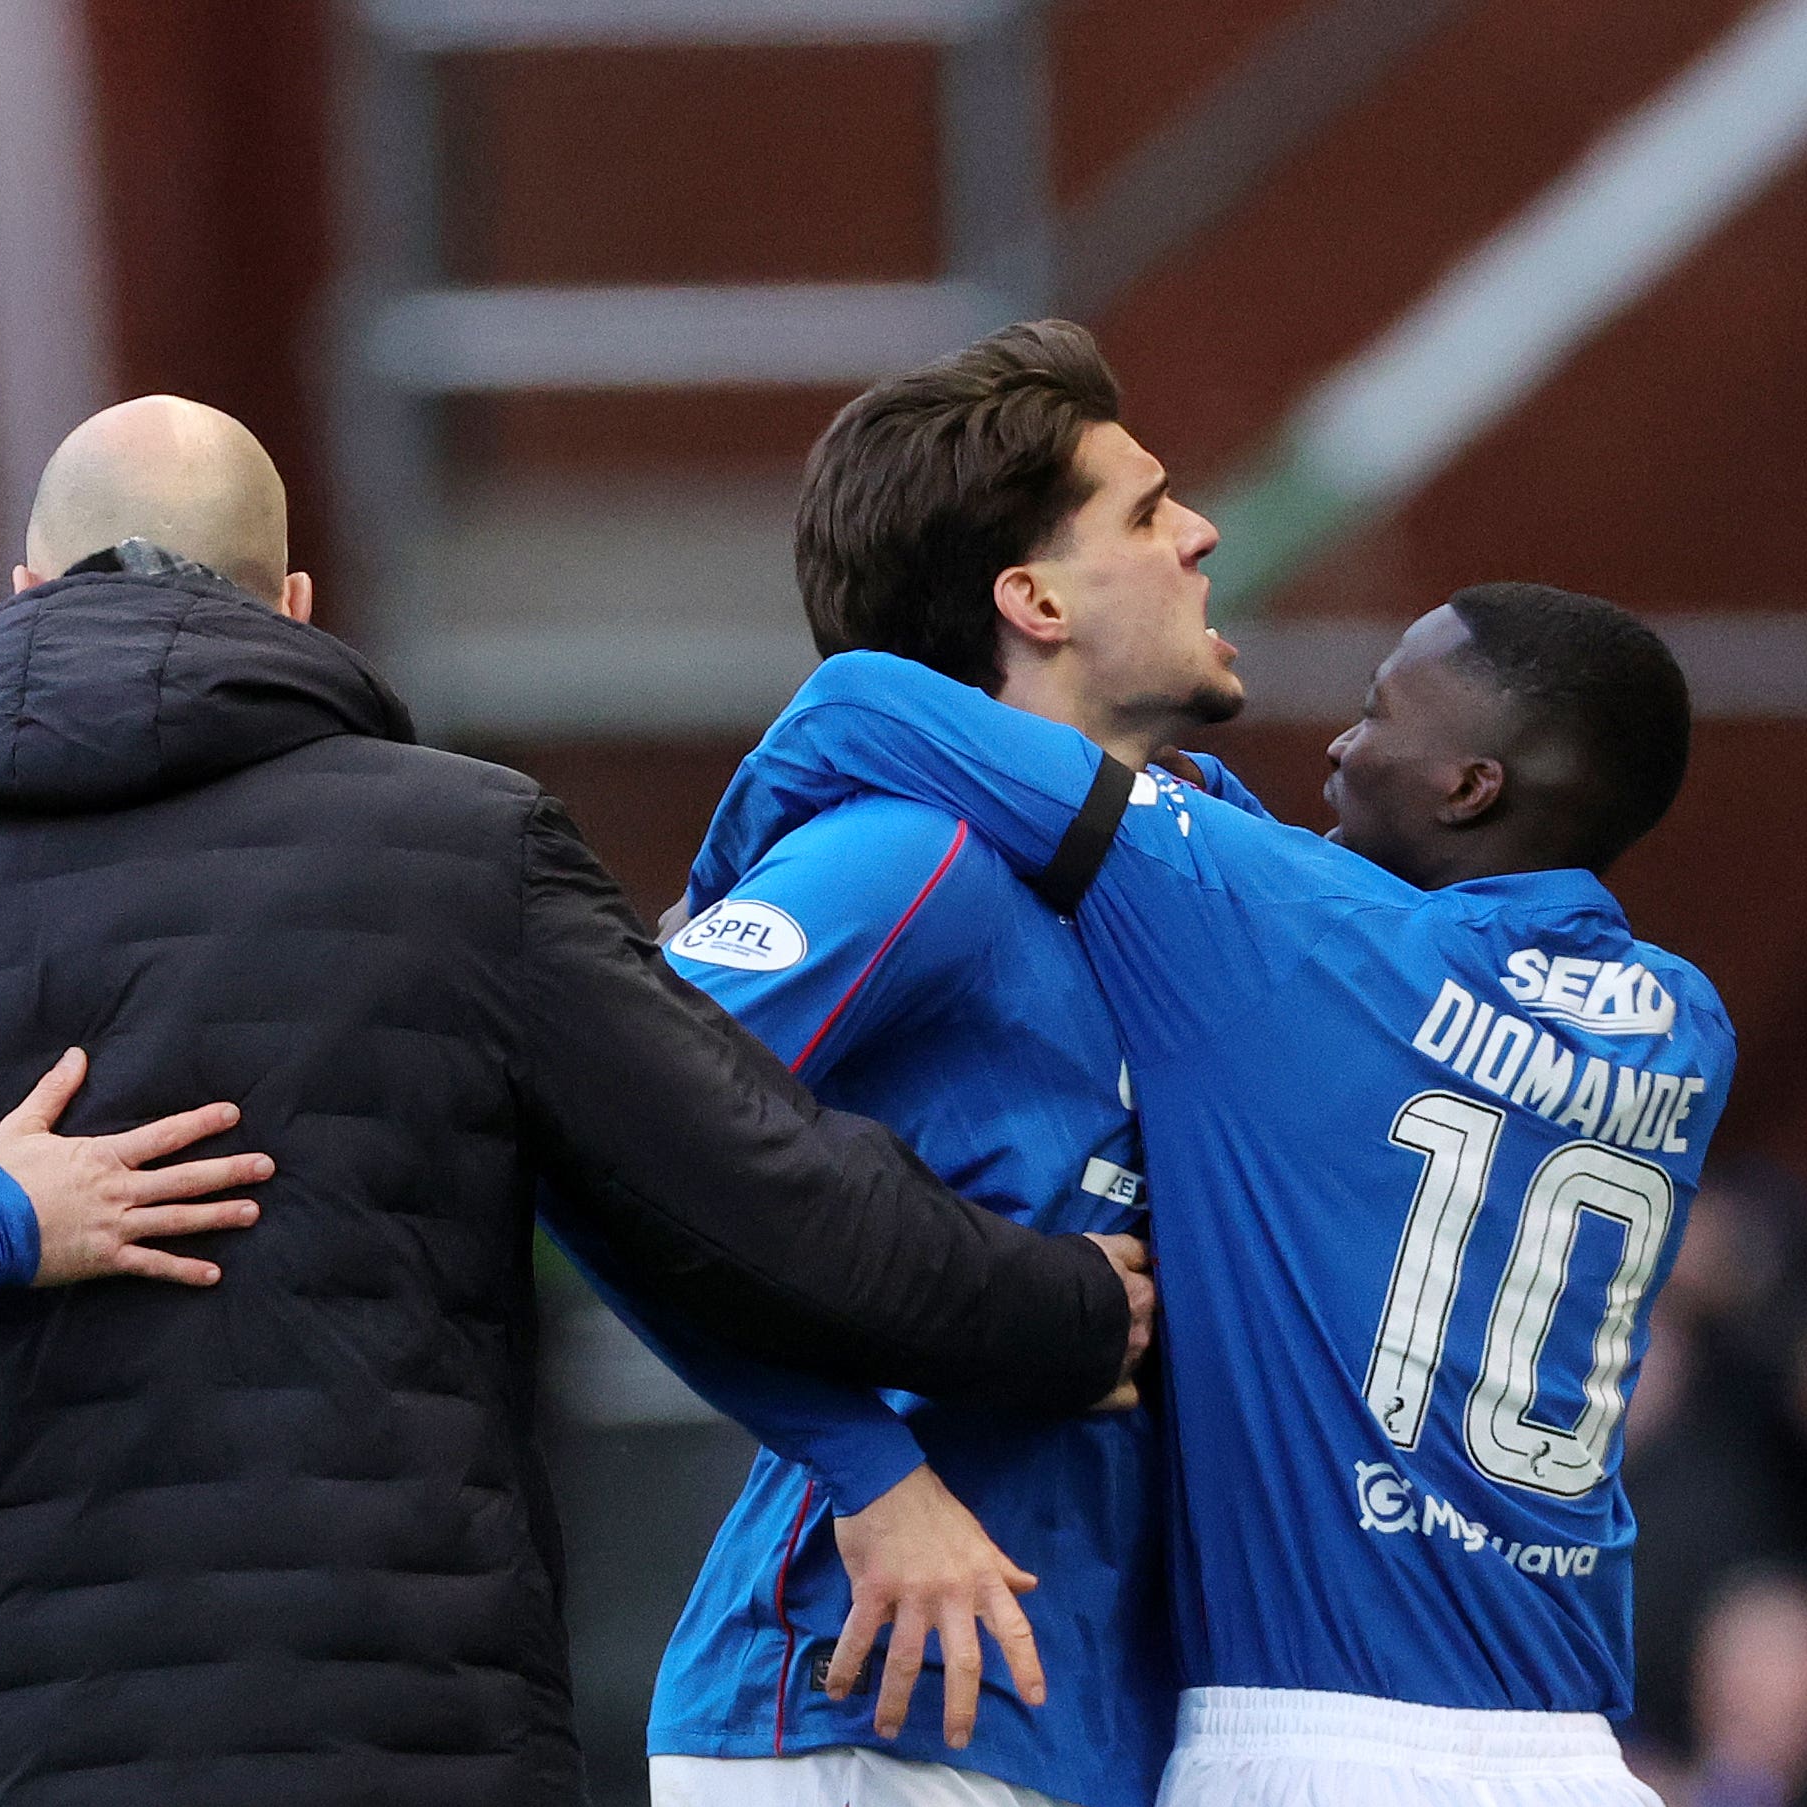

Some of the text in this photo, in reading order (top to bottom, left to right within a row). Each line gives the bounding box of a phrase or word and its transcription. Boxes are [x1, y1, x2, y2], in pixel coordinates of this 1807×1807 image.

[700, 918, 773, 952] SPFL
[1499, 947, 1677, 1036] SEKO
[1412, 978, 1706, 1153] DIOMANDE
[1362, 1088, 1676, 1500] 10
